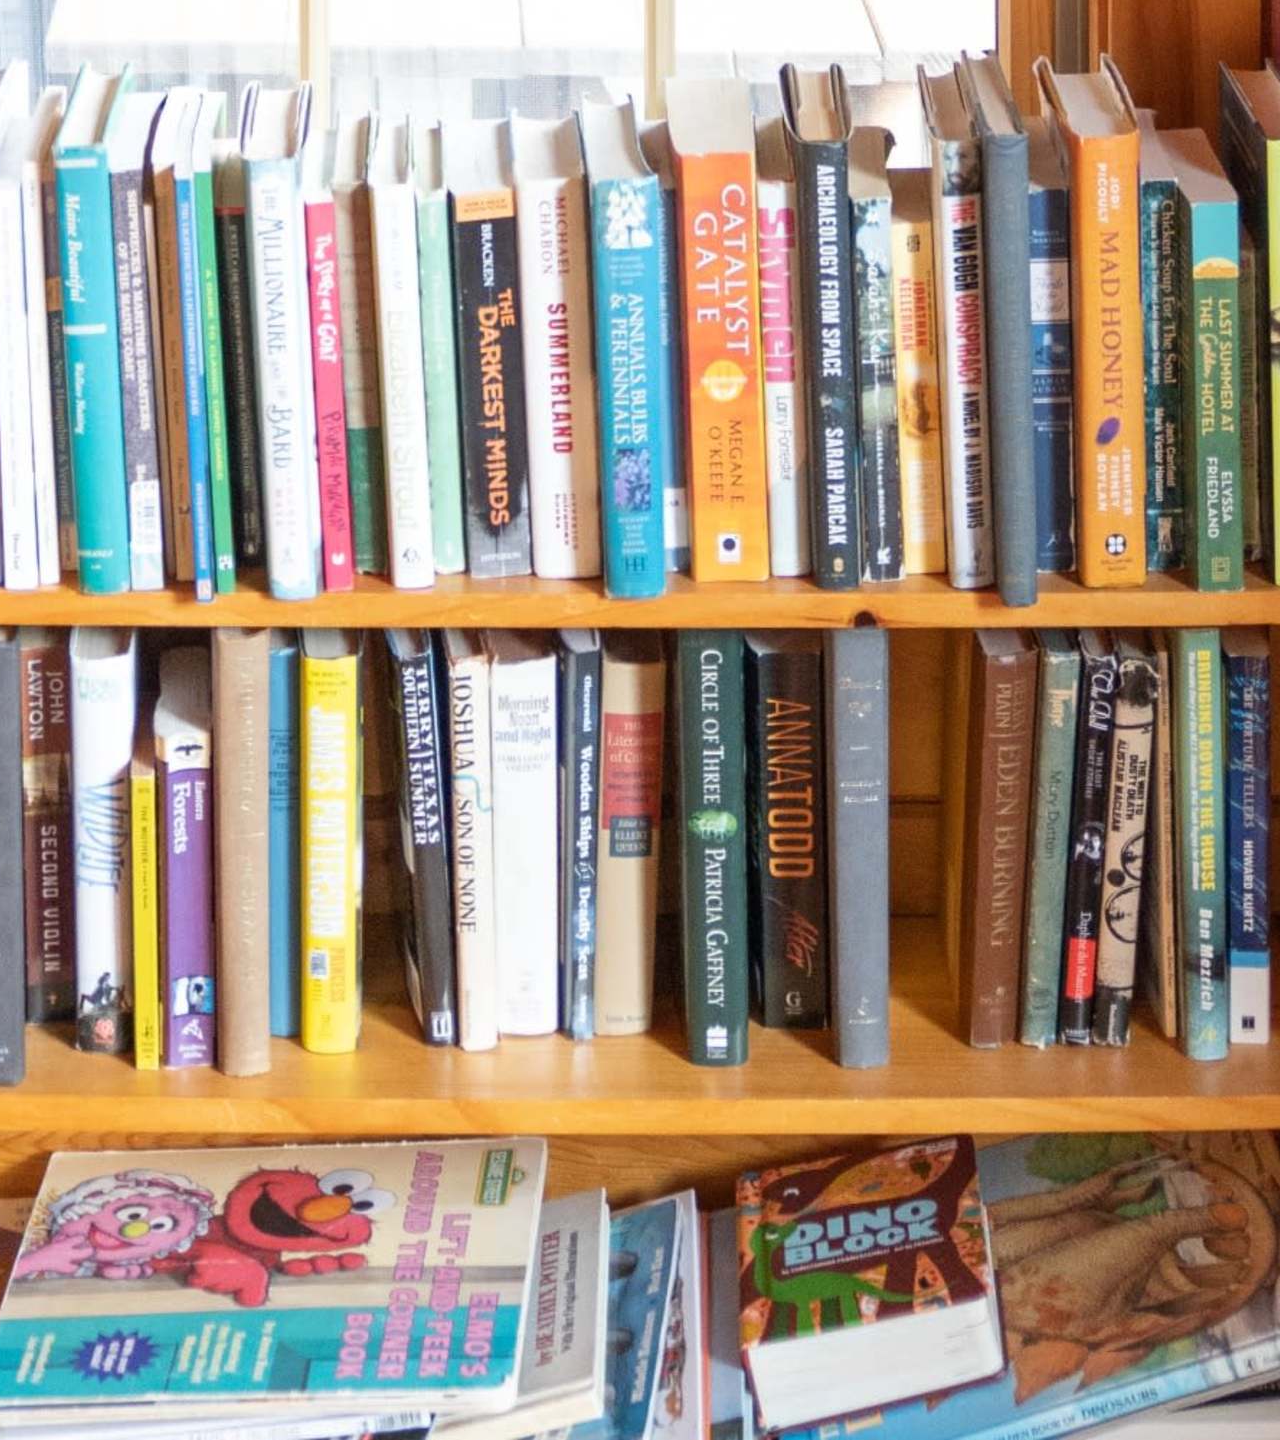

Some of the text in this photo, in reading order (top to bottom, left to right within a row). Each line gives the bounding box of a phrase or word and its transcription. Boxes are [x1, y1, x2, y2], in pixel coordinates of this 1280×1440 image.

[693, 211, 721, 325] GATE
[720, 184, 750, 355] CATALYST
[1099, 232, 1125, 411] MAD HONEY
[477, 304, 510, 526] DARKEST MINDS
[548, 302, 574, 454] SUMMERLAND
[766, 698, 816, 878] ANNA TODD
[784, 1220, 939, 1268] BLOCK
[785, 1200, 938, 1247] DINO
[335, 1312, 374, 1380] BOOK
